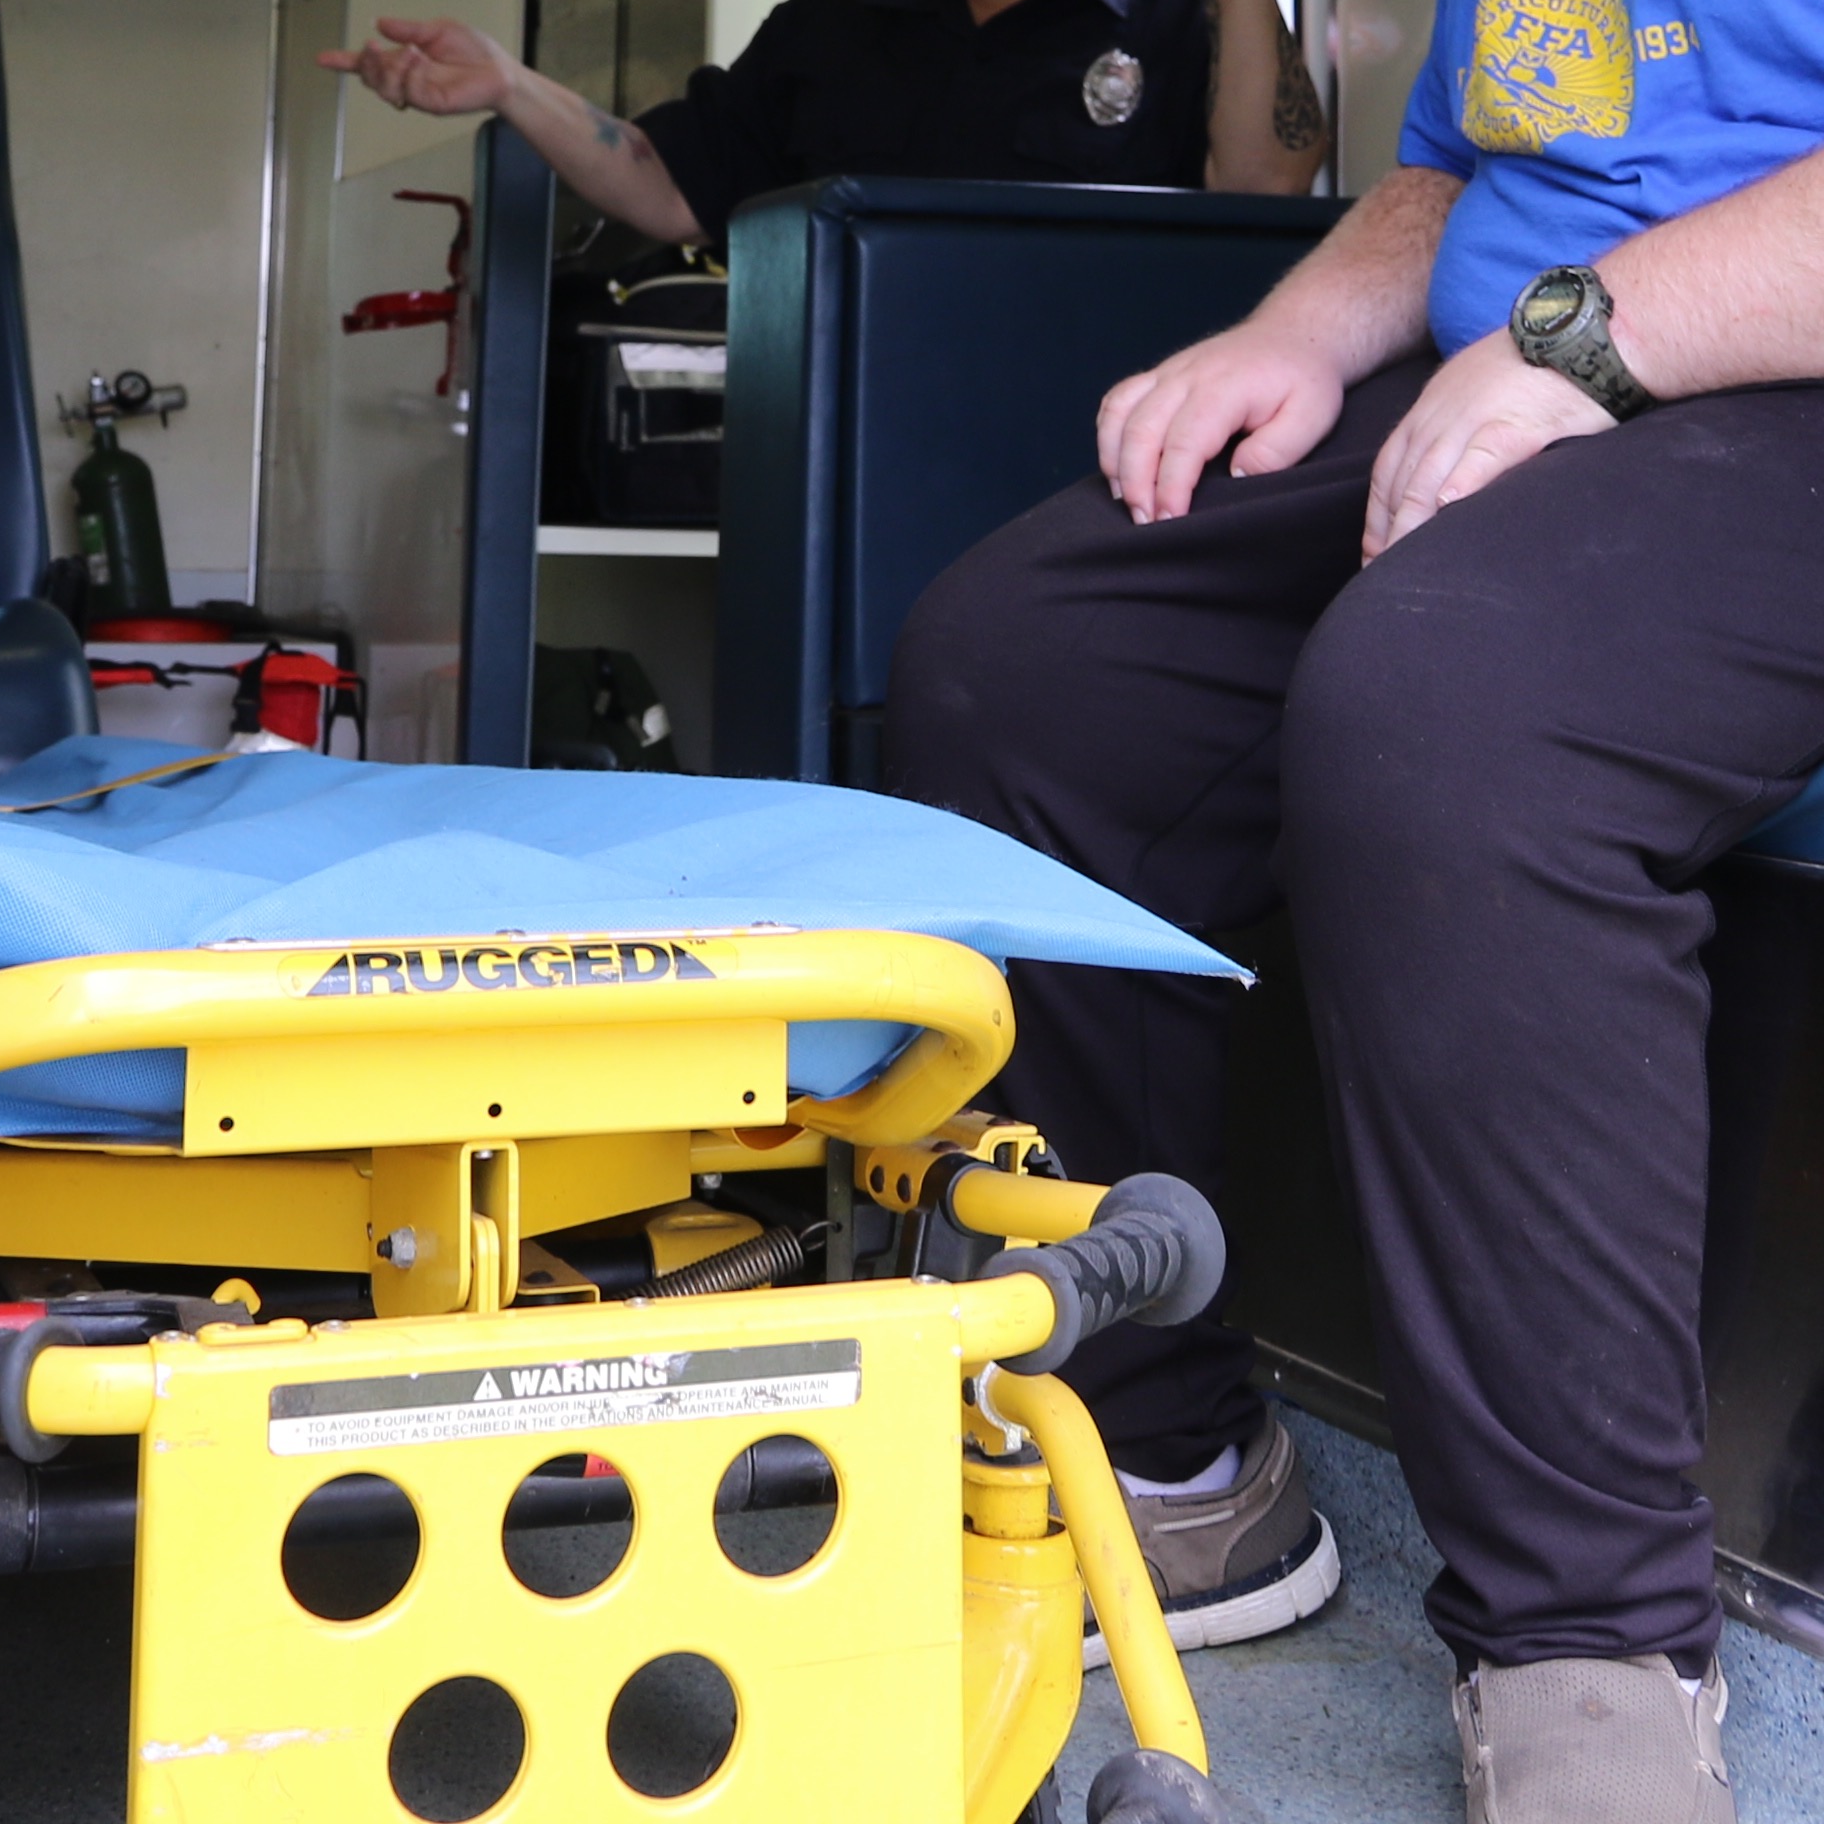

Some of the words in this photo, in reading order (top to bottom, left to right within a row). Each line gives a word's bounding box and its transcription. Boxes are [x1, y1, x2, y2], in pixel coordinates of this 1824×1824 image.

[1502, 10, 1596, 60] FFA
[354, 942, 670, 994] RUGGED
[511, 1361, 668, 1397] WARNING
[308, 1422, 325, 1434] TO
[330, 1418, 370, 1432] AVOID
[375, 1411, 452, 1427] EQUIPMENT
[458, 1406, 514, 1421] DAMAGE
[519, 1400, 568, 1414] AND/OR
[678, 1386, 737, 1402] OPERATE
[771, 1379, 829, 1395] MAINTAIN
[308, 1433, 336, 1448] THIS
[342, 1428, 406, 1445] PRODUCT
[411, 1426, 429, 1438] AS
[433, 1419, 510, 1438] DESCRIBED
[514, 1419, 526, 1431] IN
[531, 1415, 556, 1428] THE
[560, 1407, 643, 1426] OPERATIONS
[647, 1403, 674, 1421] AND
[678, 1400, 769, 1416] MAINTENANCE
